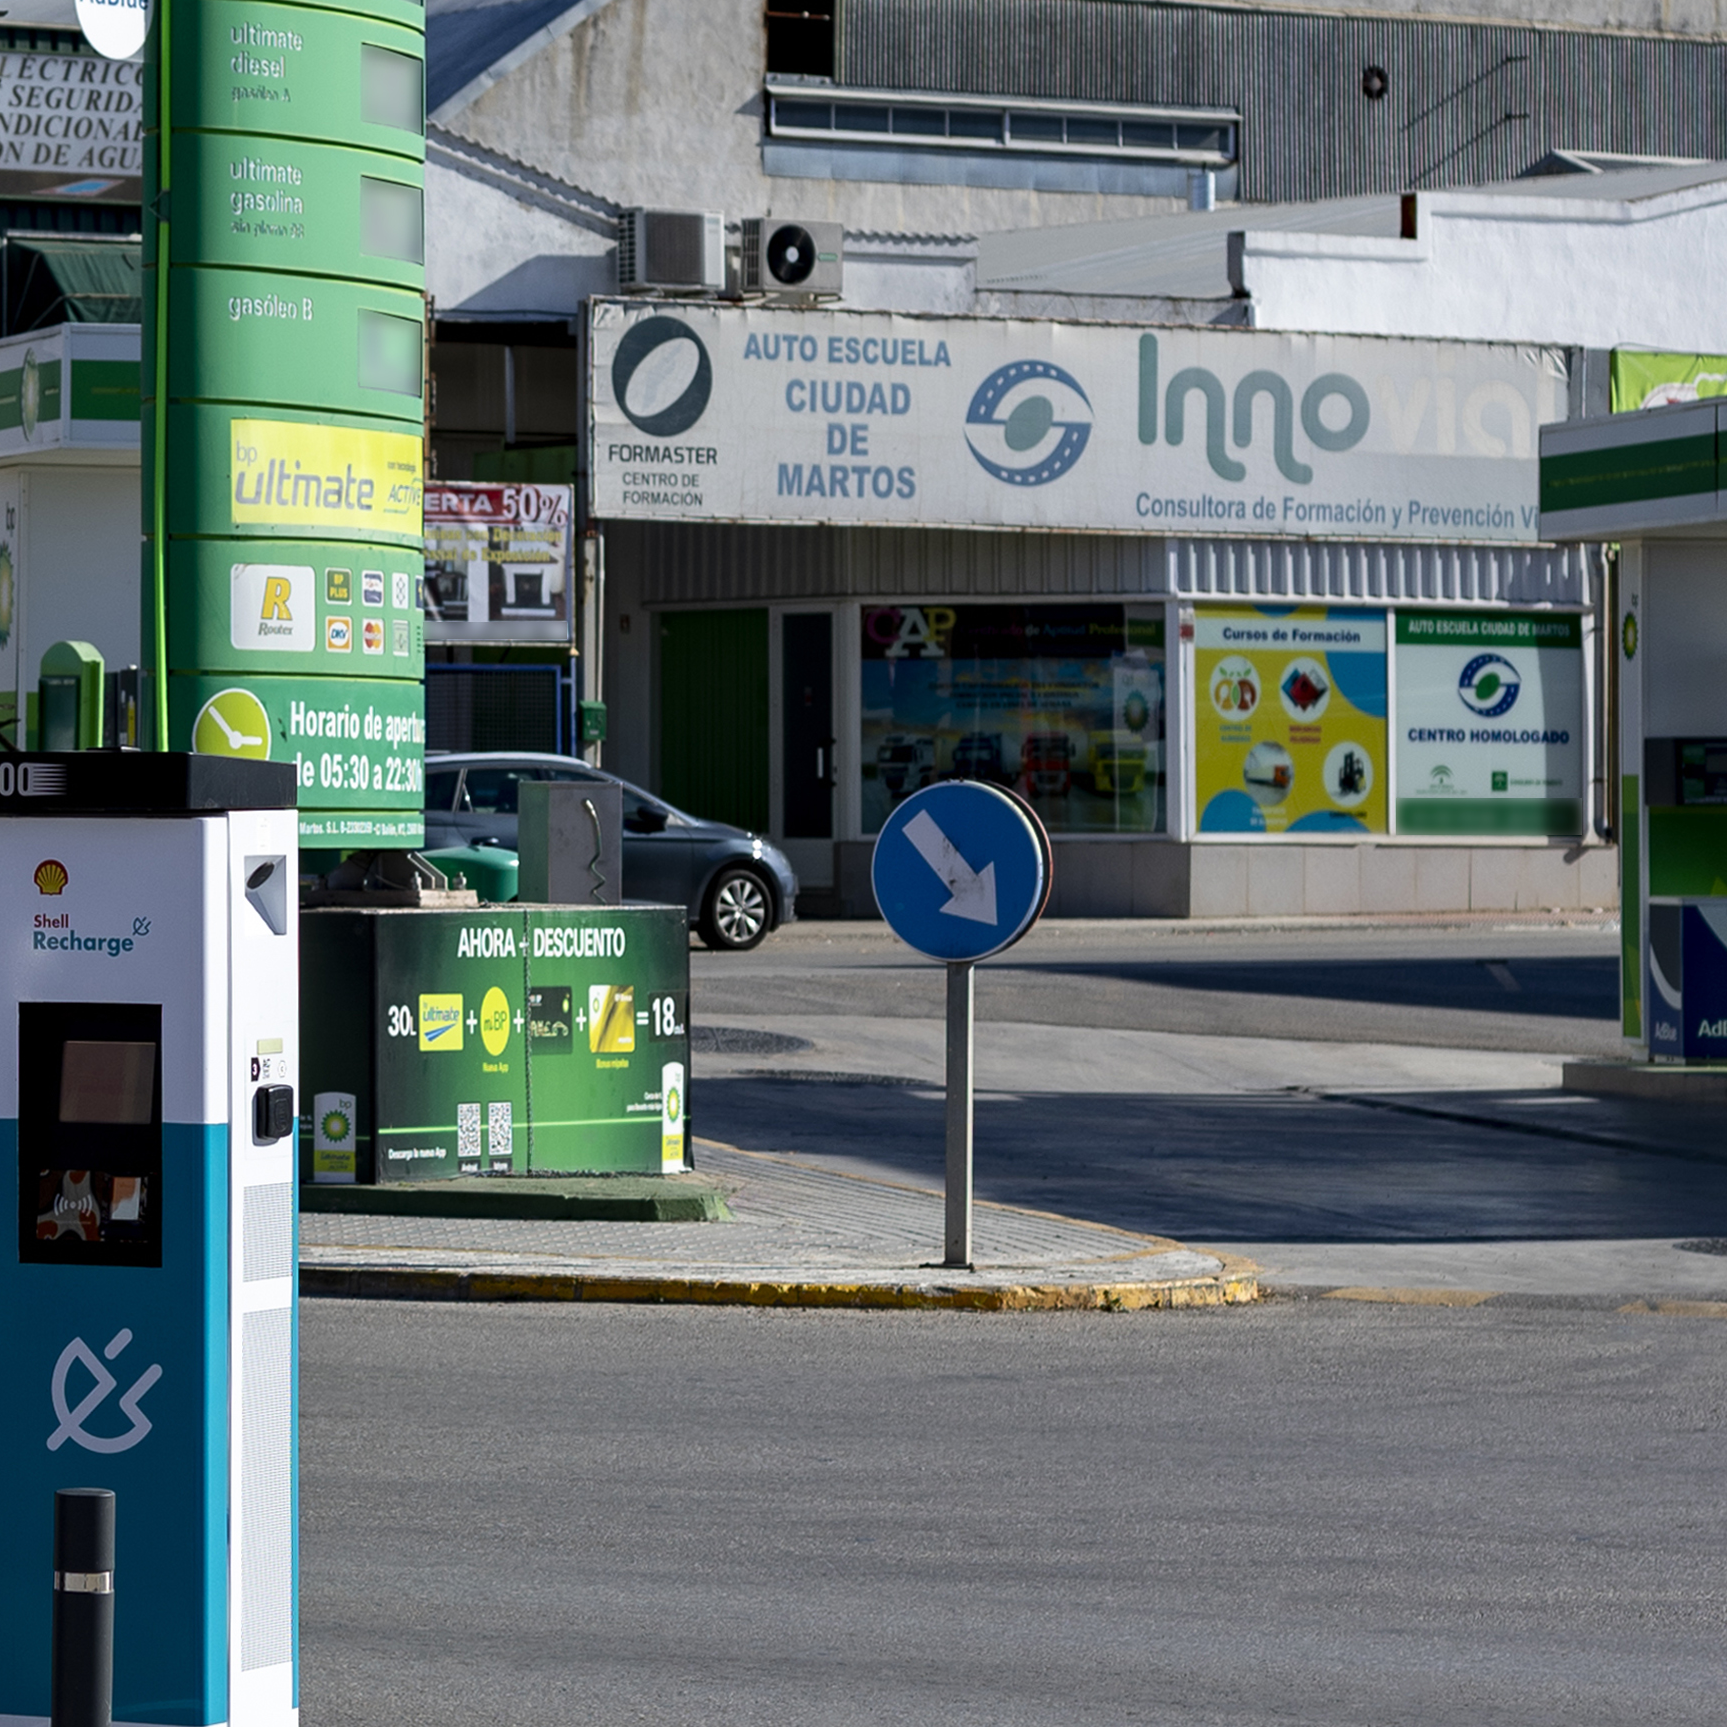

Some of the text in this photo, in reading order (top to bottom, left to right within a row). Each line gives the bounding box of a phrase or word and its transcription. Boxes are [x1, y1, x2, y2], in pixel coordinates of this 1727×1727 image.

[231, 22, 303, 51] ultimate
[231, 51, 285, 78] diesel
[9, 85, 142, 114] SEGURID
[33, 142, 71, 166] DE
[230, 157, 302, 185] ultimate
[230, 189, 303, 215] gasolina
[231, 219, 250, 234] sin
[229, 296, 313, 320] gasóleo B
[743, 333, 952, 367] AUTO ESCUELA
[785, 379, 912, 415] CIUDAD
[236, 440, 257, 467] bp
[827, 424, 870, 456] DE
[608, 444, 718, 465] FORMASTER
[234, 458, 374, 511] ultimate
[622, 472, 700, 488] CENTRO DE
[777, 463, 916, 499] MARTOS
[424, 485, 569, 527] ERTA 50%
[622, 489, 704, 507] FORMACIÓN
[1135, 491, 1538, 529] Consultora de Formación y Prevención Vi
[261, 576, 293, 621] R
[330, 587, 348, 599] PLUS
[258, 622, 293, 636] Routex
[331, 628, 348, 640] DKV
[866, 607, 957, 658] CAP
[1223, 627, 1360, 642] Cursos de Formación
[1409, 619, 1571, 637] AUTO ESCUELA CIUDAD DE MARTOS
[290, 700, 360, 740] Horario
[364, 706, 382, 741] de
[1408, 728, 1570, 745] CENTRO HOMOLOGADO
[320, 753, 369, 790] 05:30
[373, 764, 383, 790] a
[34, 913, 69, 928] Shell
[33, 929, 134, 957] Recharge
[457, 927, 626, 958] AHORA DESCUENTO
[423, 1006, 459, 1022] ultimate
